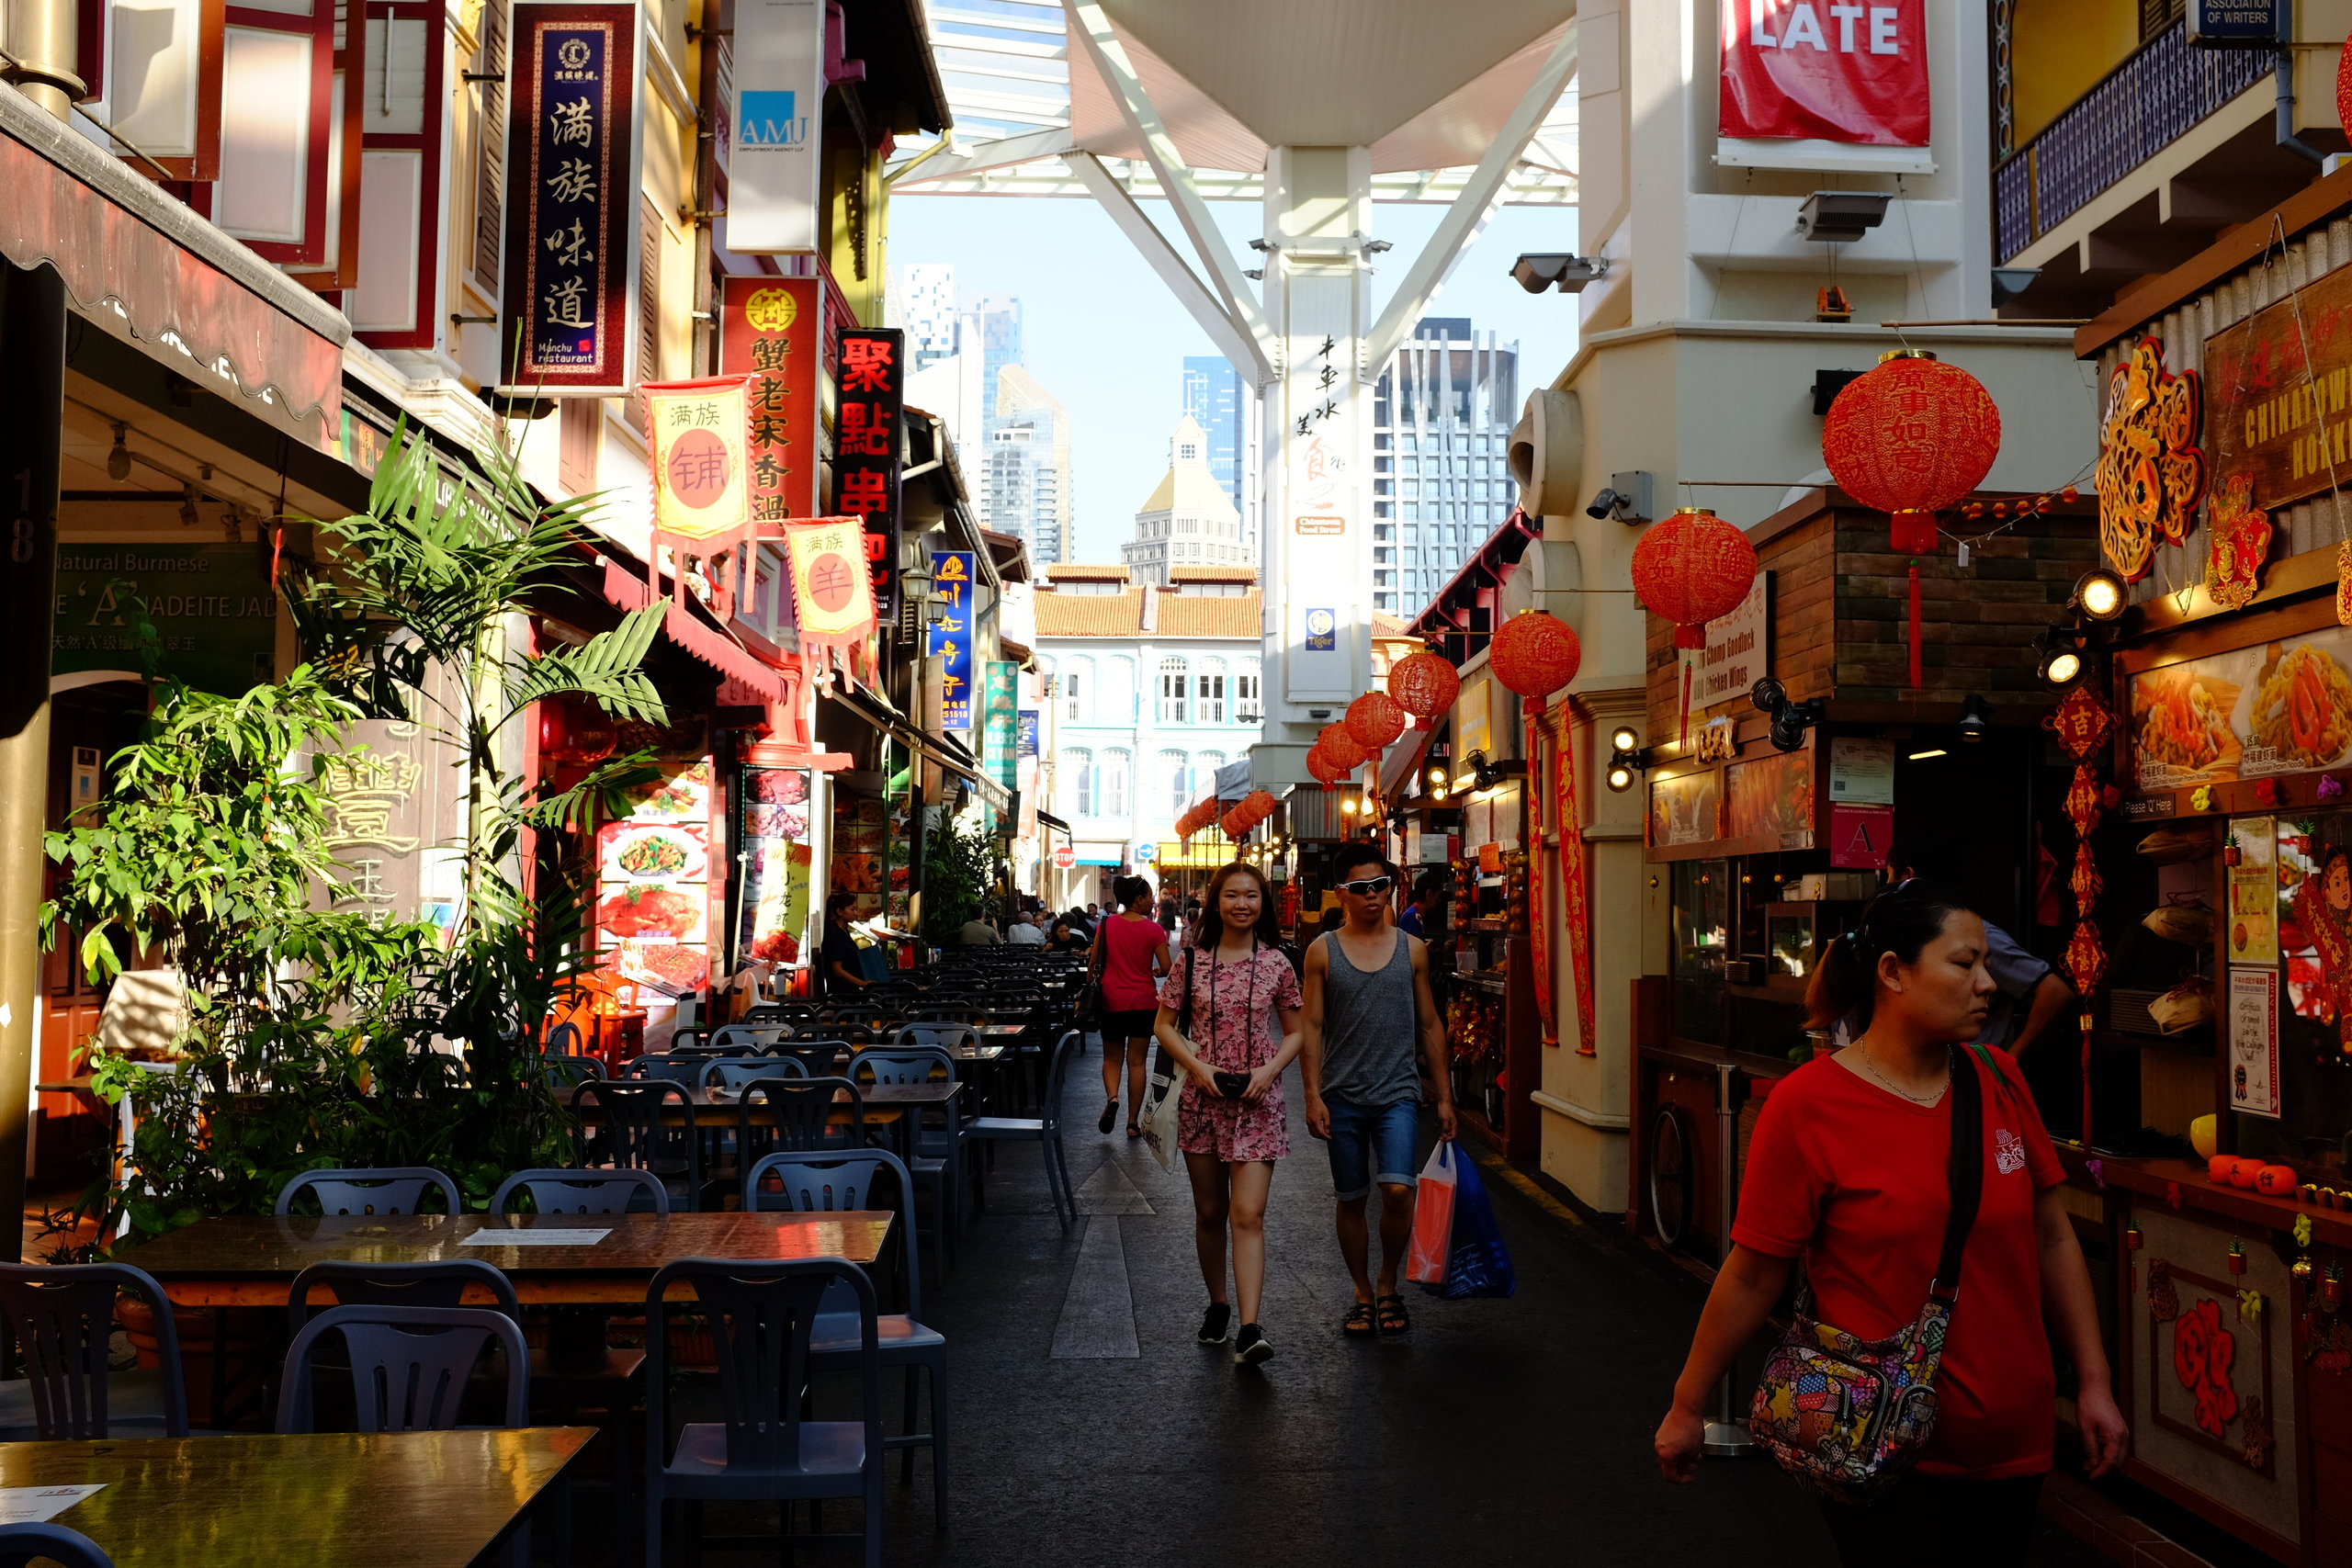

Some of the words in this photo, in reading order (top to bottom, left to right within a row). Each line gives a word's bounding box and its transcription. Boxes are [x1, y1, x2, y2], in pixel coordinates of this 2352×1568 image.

[2206, 0, 2270, 8] ASSOCIATION
[1750, 0, 1898, 54] LATE
[2208, 12, 2221, 23] OF
[2224, 12, 2267, 23] WRITERS
[739, 118, 808, 145] AMJ
[546, 96, 597, 329] 满族味道
[538, 354, 594, 363] restaurant
[671, 402, 720, 427] 满族
[2245, 365, 2352, 448] CHINATOW
[671, 446, 728, 491] 铺
[807, 533, 843, 553] 满族
[125, 553, 209, 572] Burmese
[812, 563, 854, 600] 羊
[1308, 637, 1332, 649] Tiger
[1706, 642, 1725, 667] Chomp
[1726, 628, 1755, 658] Goodluck
[1706, 671, 1728, 696] Chicken
[1729, 666, 1748, 688] Wings
[2070, 705, 2092, 738] 吉
[2288, 759, 2305, 768] Noodle
[2125, 802, 2146, 814] Please
[2156, 798, 2172, 811] Here
[1846, 821, 1876, 852] A
[1055, 853, 1074, 862] STOP
